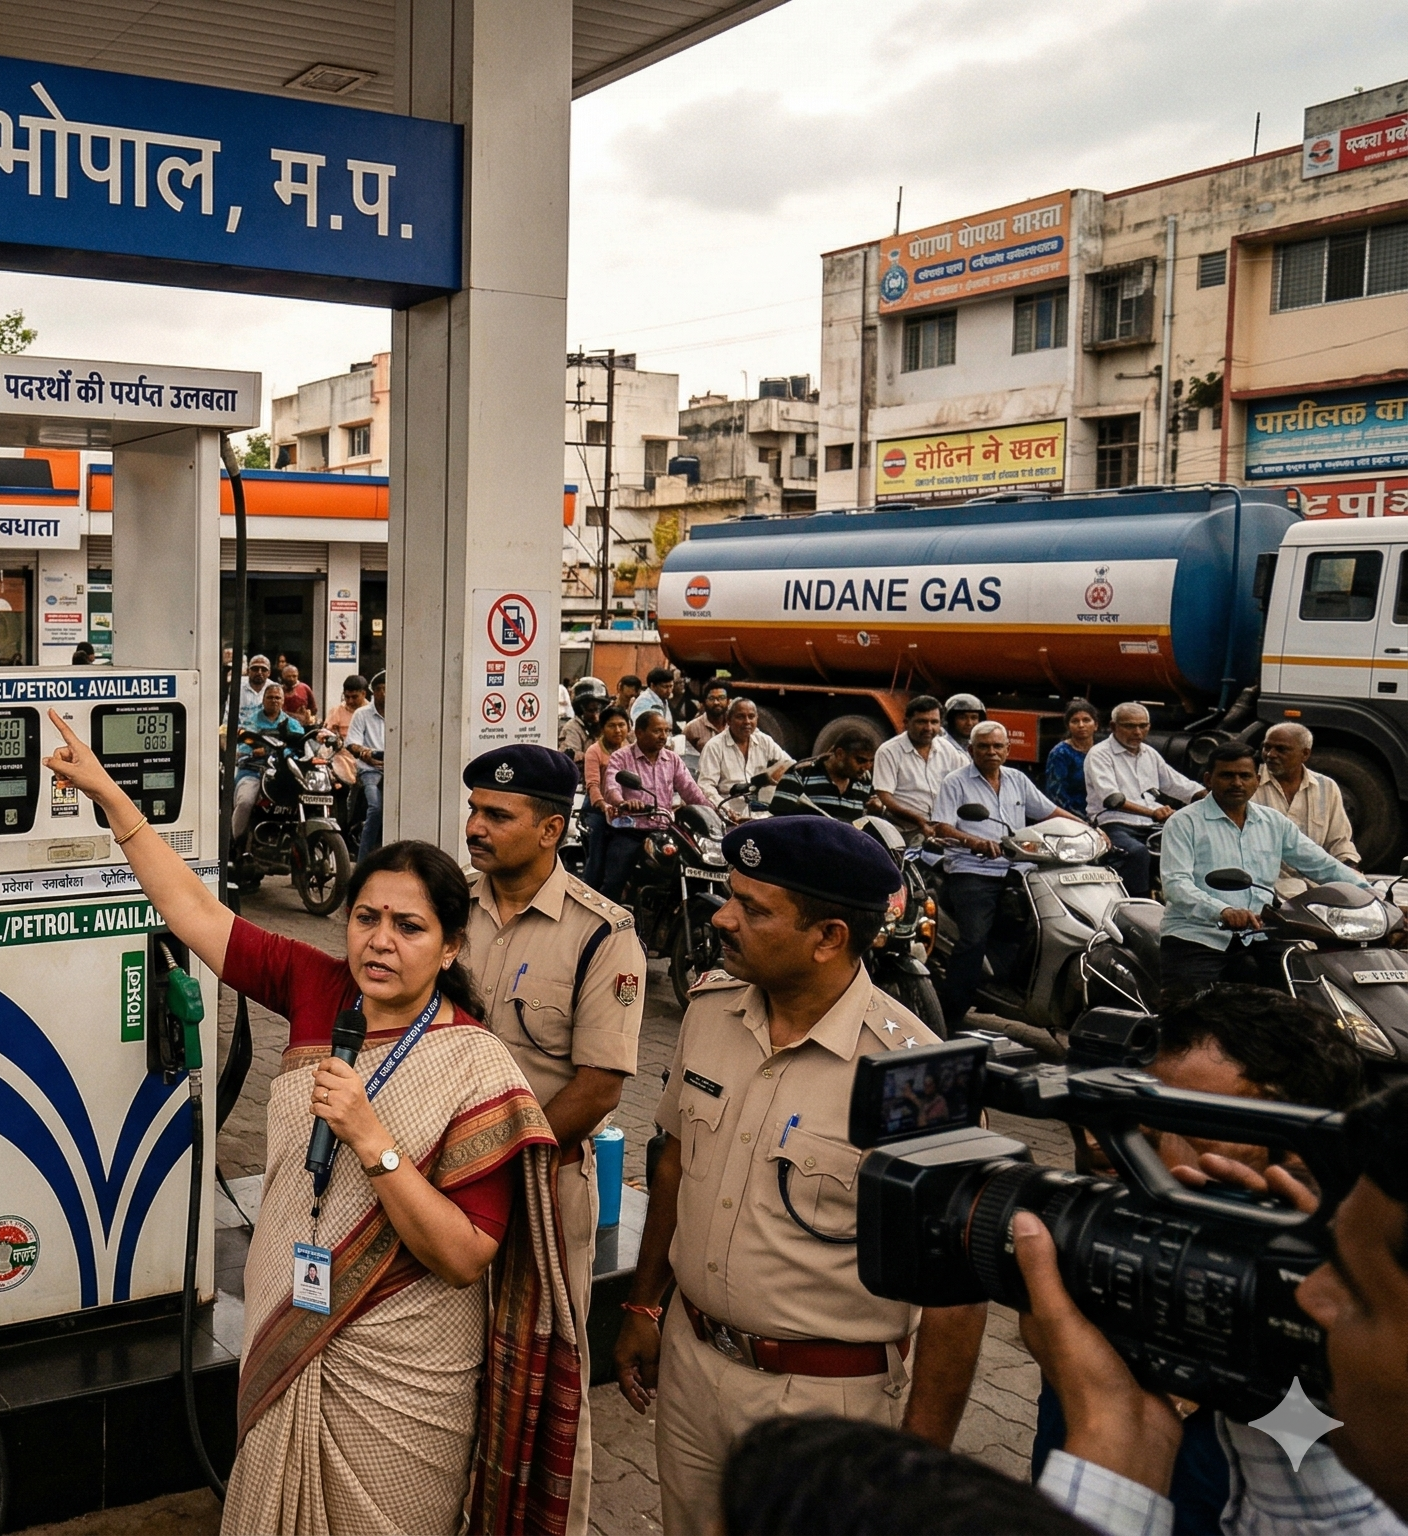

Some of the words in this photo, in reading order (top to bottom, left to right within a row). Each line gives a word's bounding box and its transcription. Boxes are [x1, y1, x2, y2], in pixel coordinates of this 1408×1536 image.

[272, 146, 415, 240] म.प.
[75, 371, 106, 404] की
[782, 578, 910, 612] INDANE
[919, 576, 1002, 613] GAS
[87, 678, 168, 698] AVAILABLE
